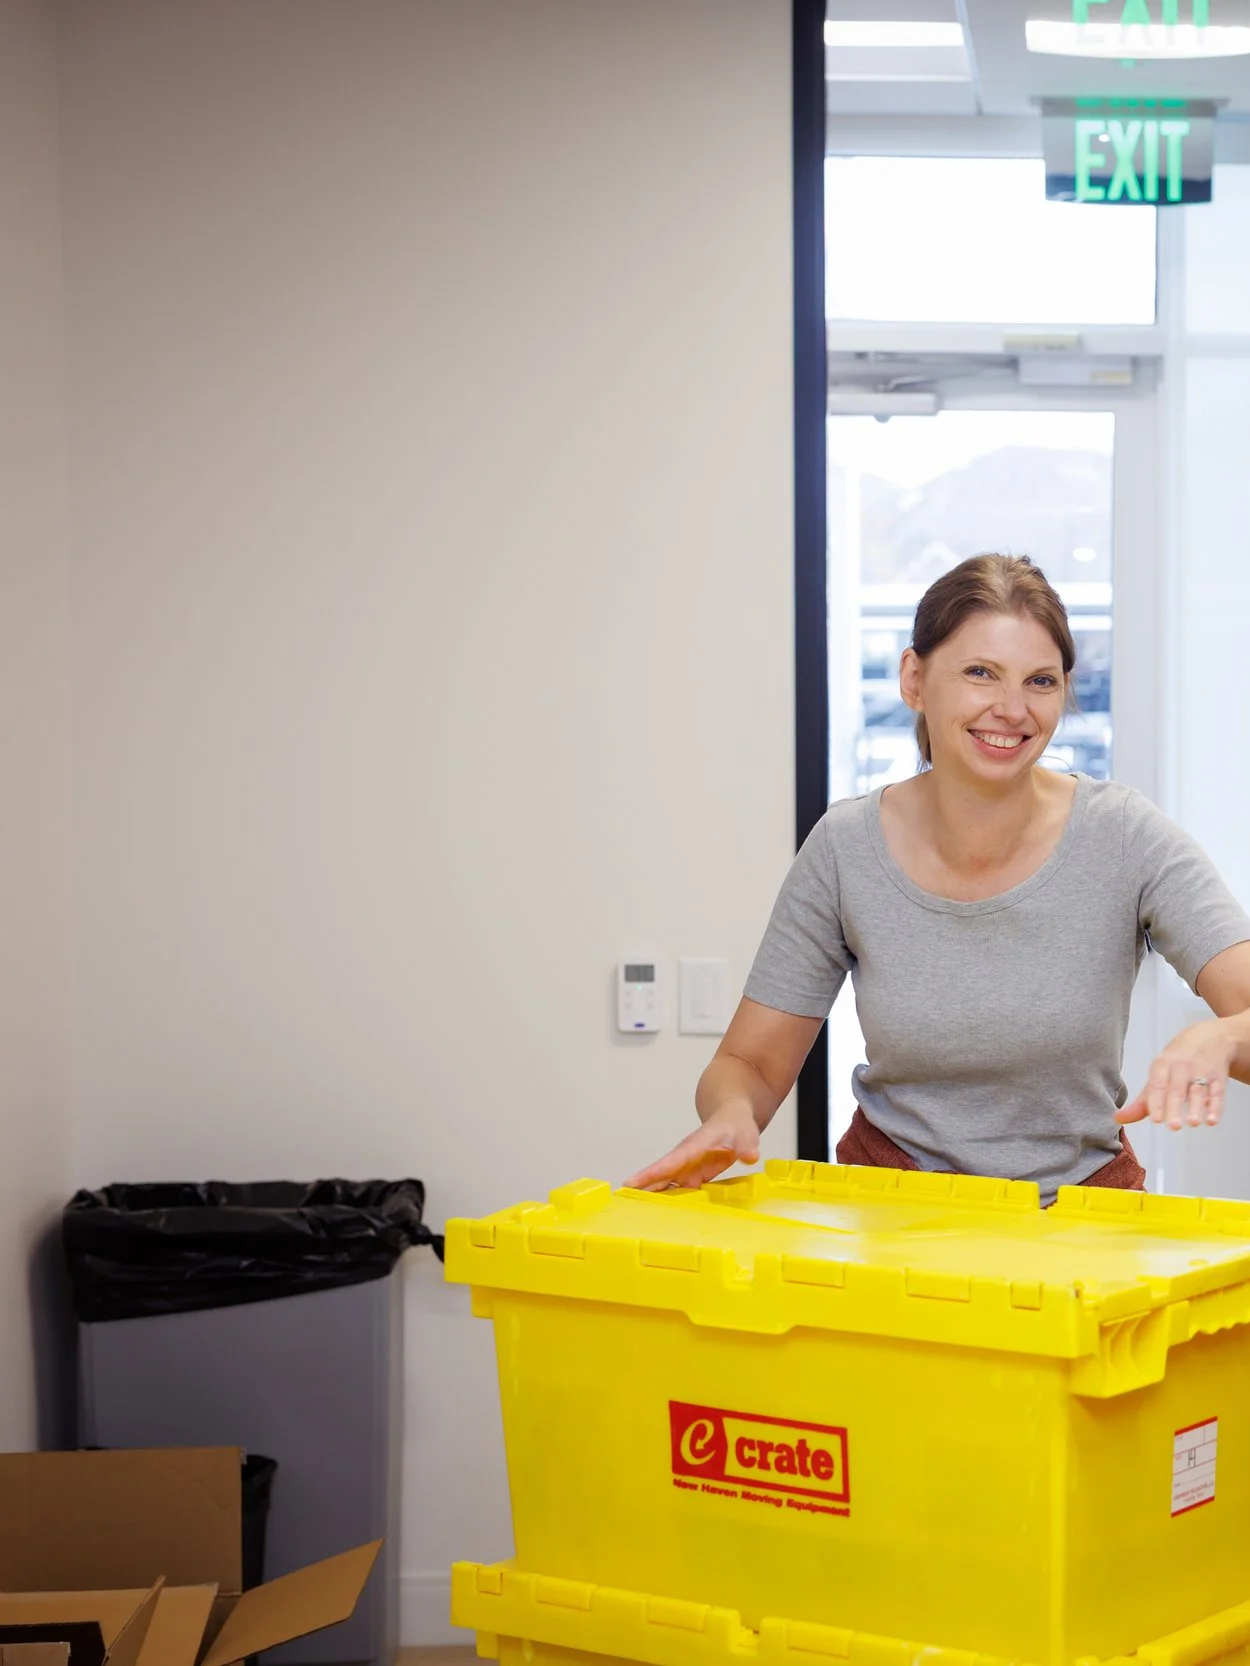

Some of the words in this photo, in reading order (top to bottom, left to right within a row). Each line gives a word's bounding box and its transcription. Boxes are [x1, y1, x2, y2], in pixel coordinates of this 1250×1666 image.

[1074, 120, 1190, 202] EXIT
[735, 1436, 834, 1481] crate
[673, 1478, 699, 1491] New
[701, 1484, 738, 1499] Haven
[741, 1491, 783, 1508] Moving
[786, 1498, 850, 1518] Equipment
